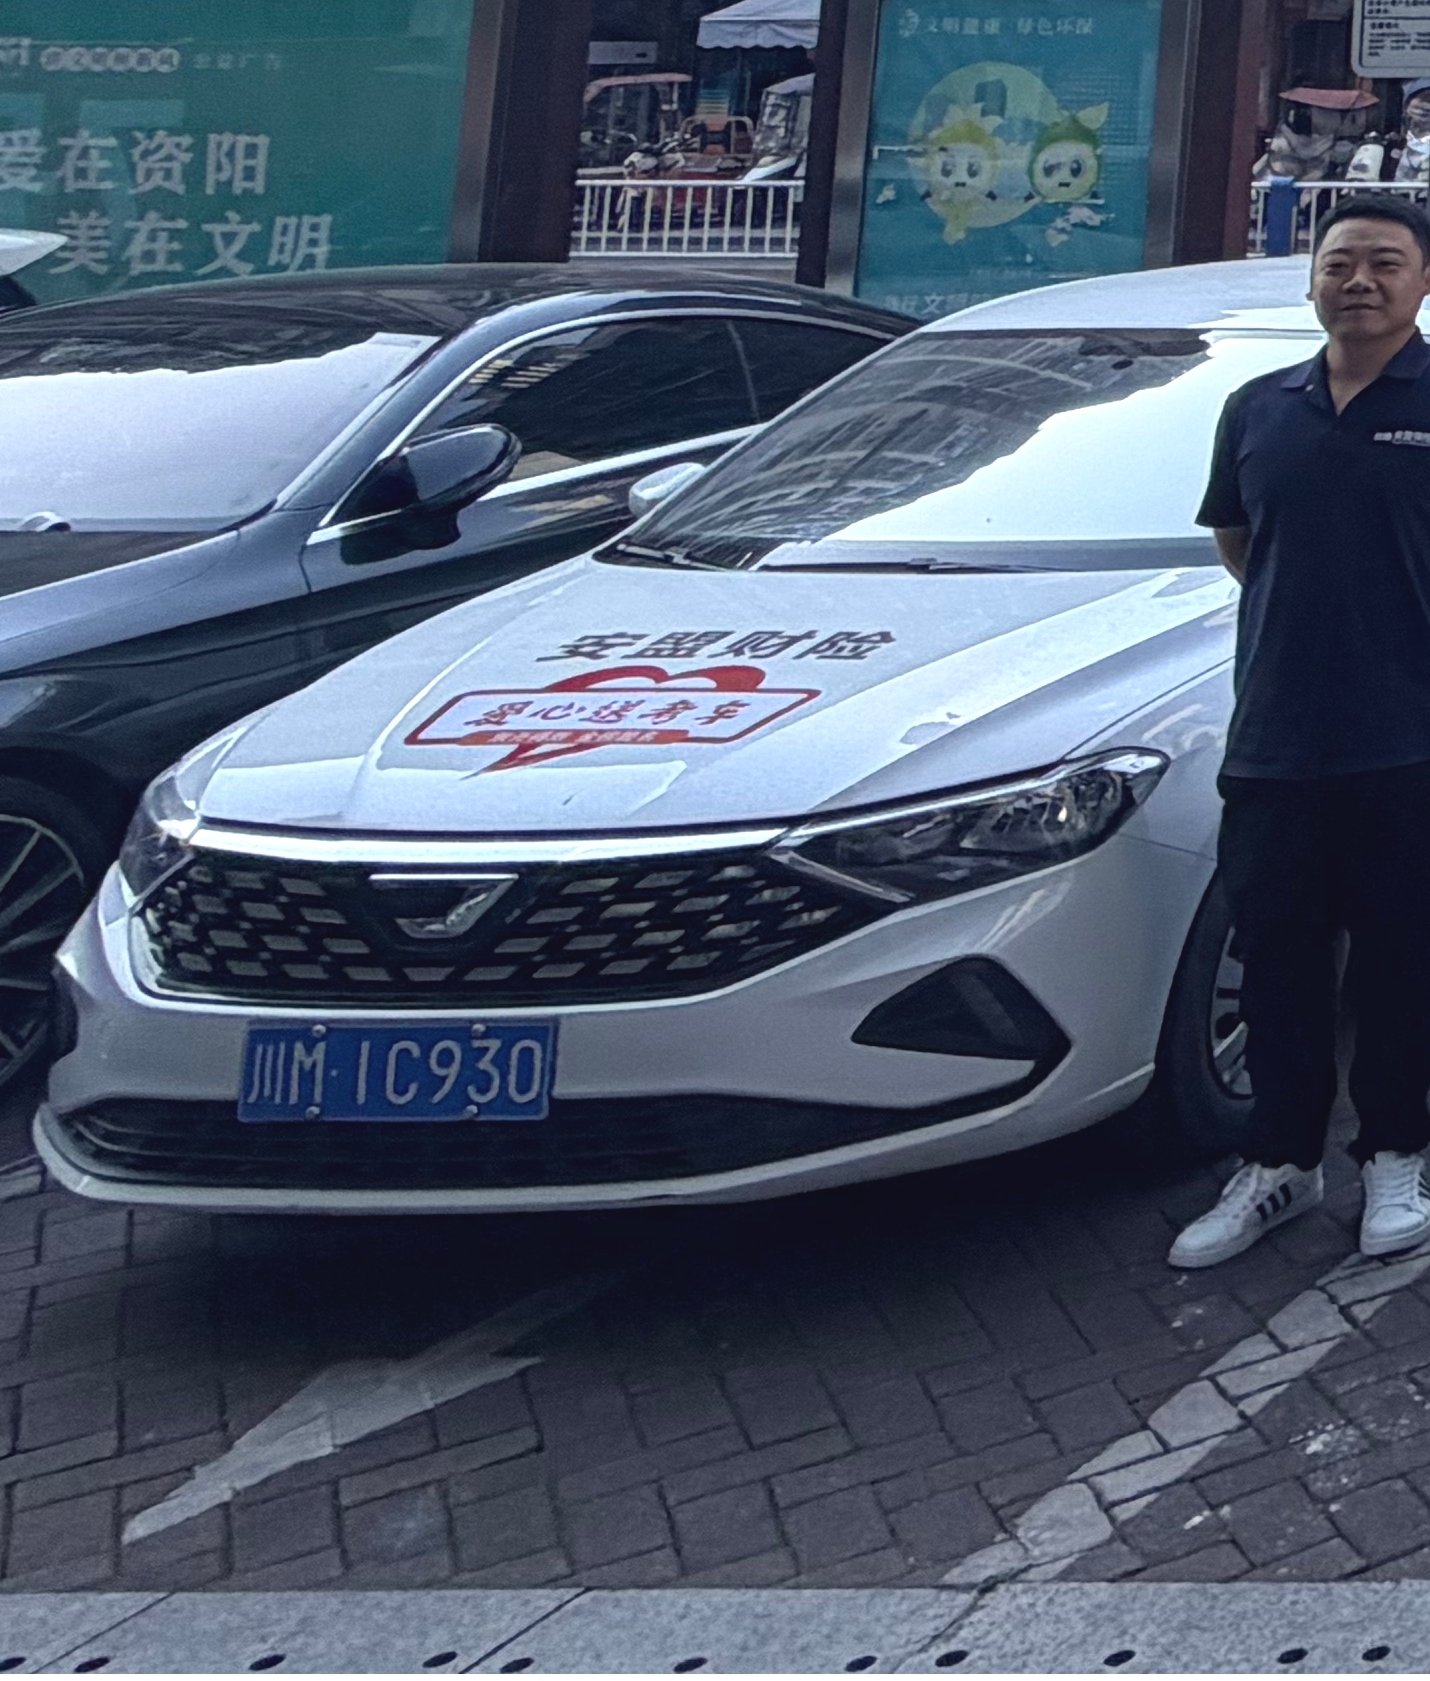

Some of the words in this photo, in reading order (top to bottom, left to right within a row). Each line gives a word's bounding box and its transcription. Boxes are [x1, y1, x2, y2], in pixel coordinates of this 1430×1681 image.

[48, 213, 333, 276] 美在文明
[535, 629, 896, 663] 安盟财险
[463, 698, 753, 727] 爱心送考车
